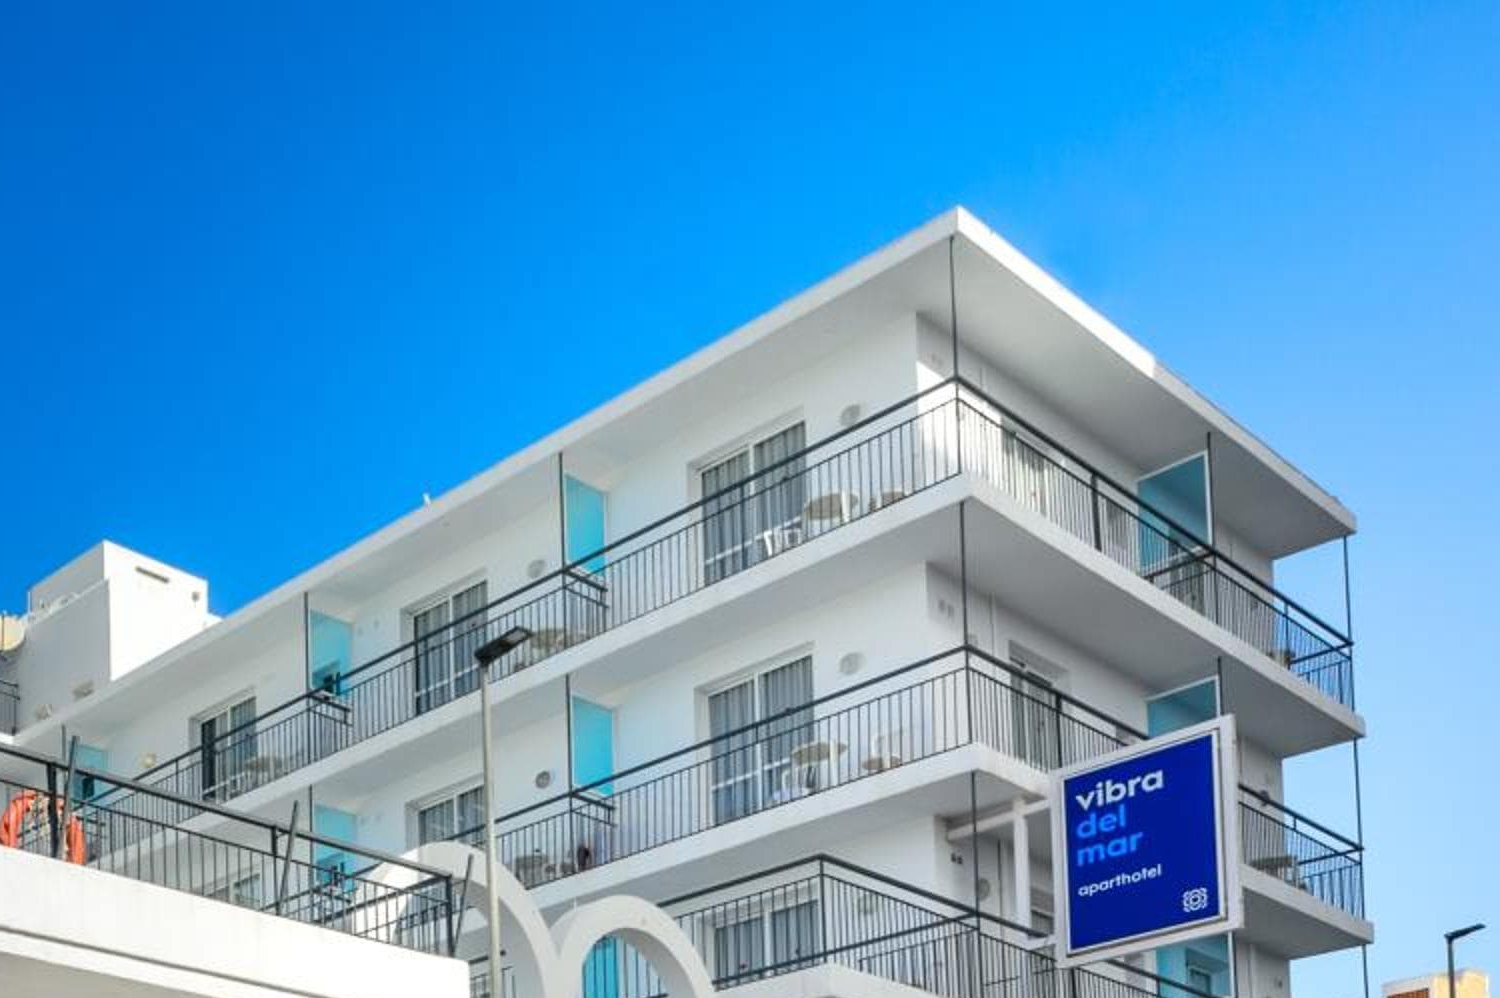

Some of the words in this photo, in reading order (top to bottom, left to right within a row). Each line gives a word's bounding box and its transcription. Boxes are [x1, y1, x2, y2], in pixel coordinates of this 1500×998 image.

[1075, 770, 1164, 811] vibra
[1076, 804, 1127, 839] del
[1077, 832, 1143, 866] mar
[1078, 864, 1163, 897] aparthotel
